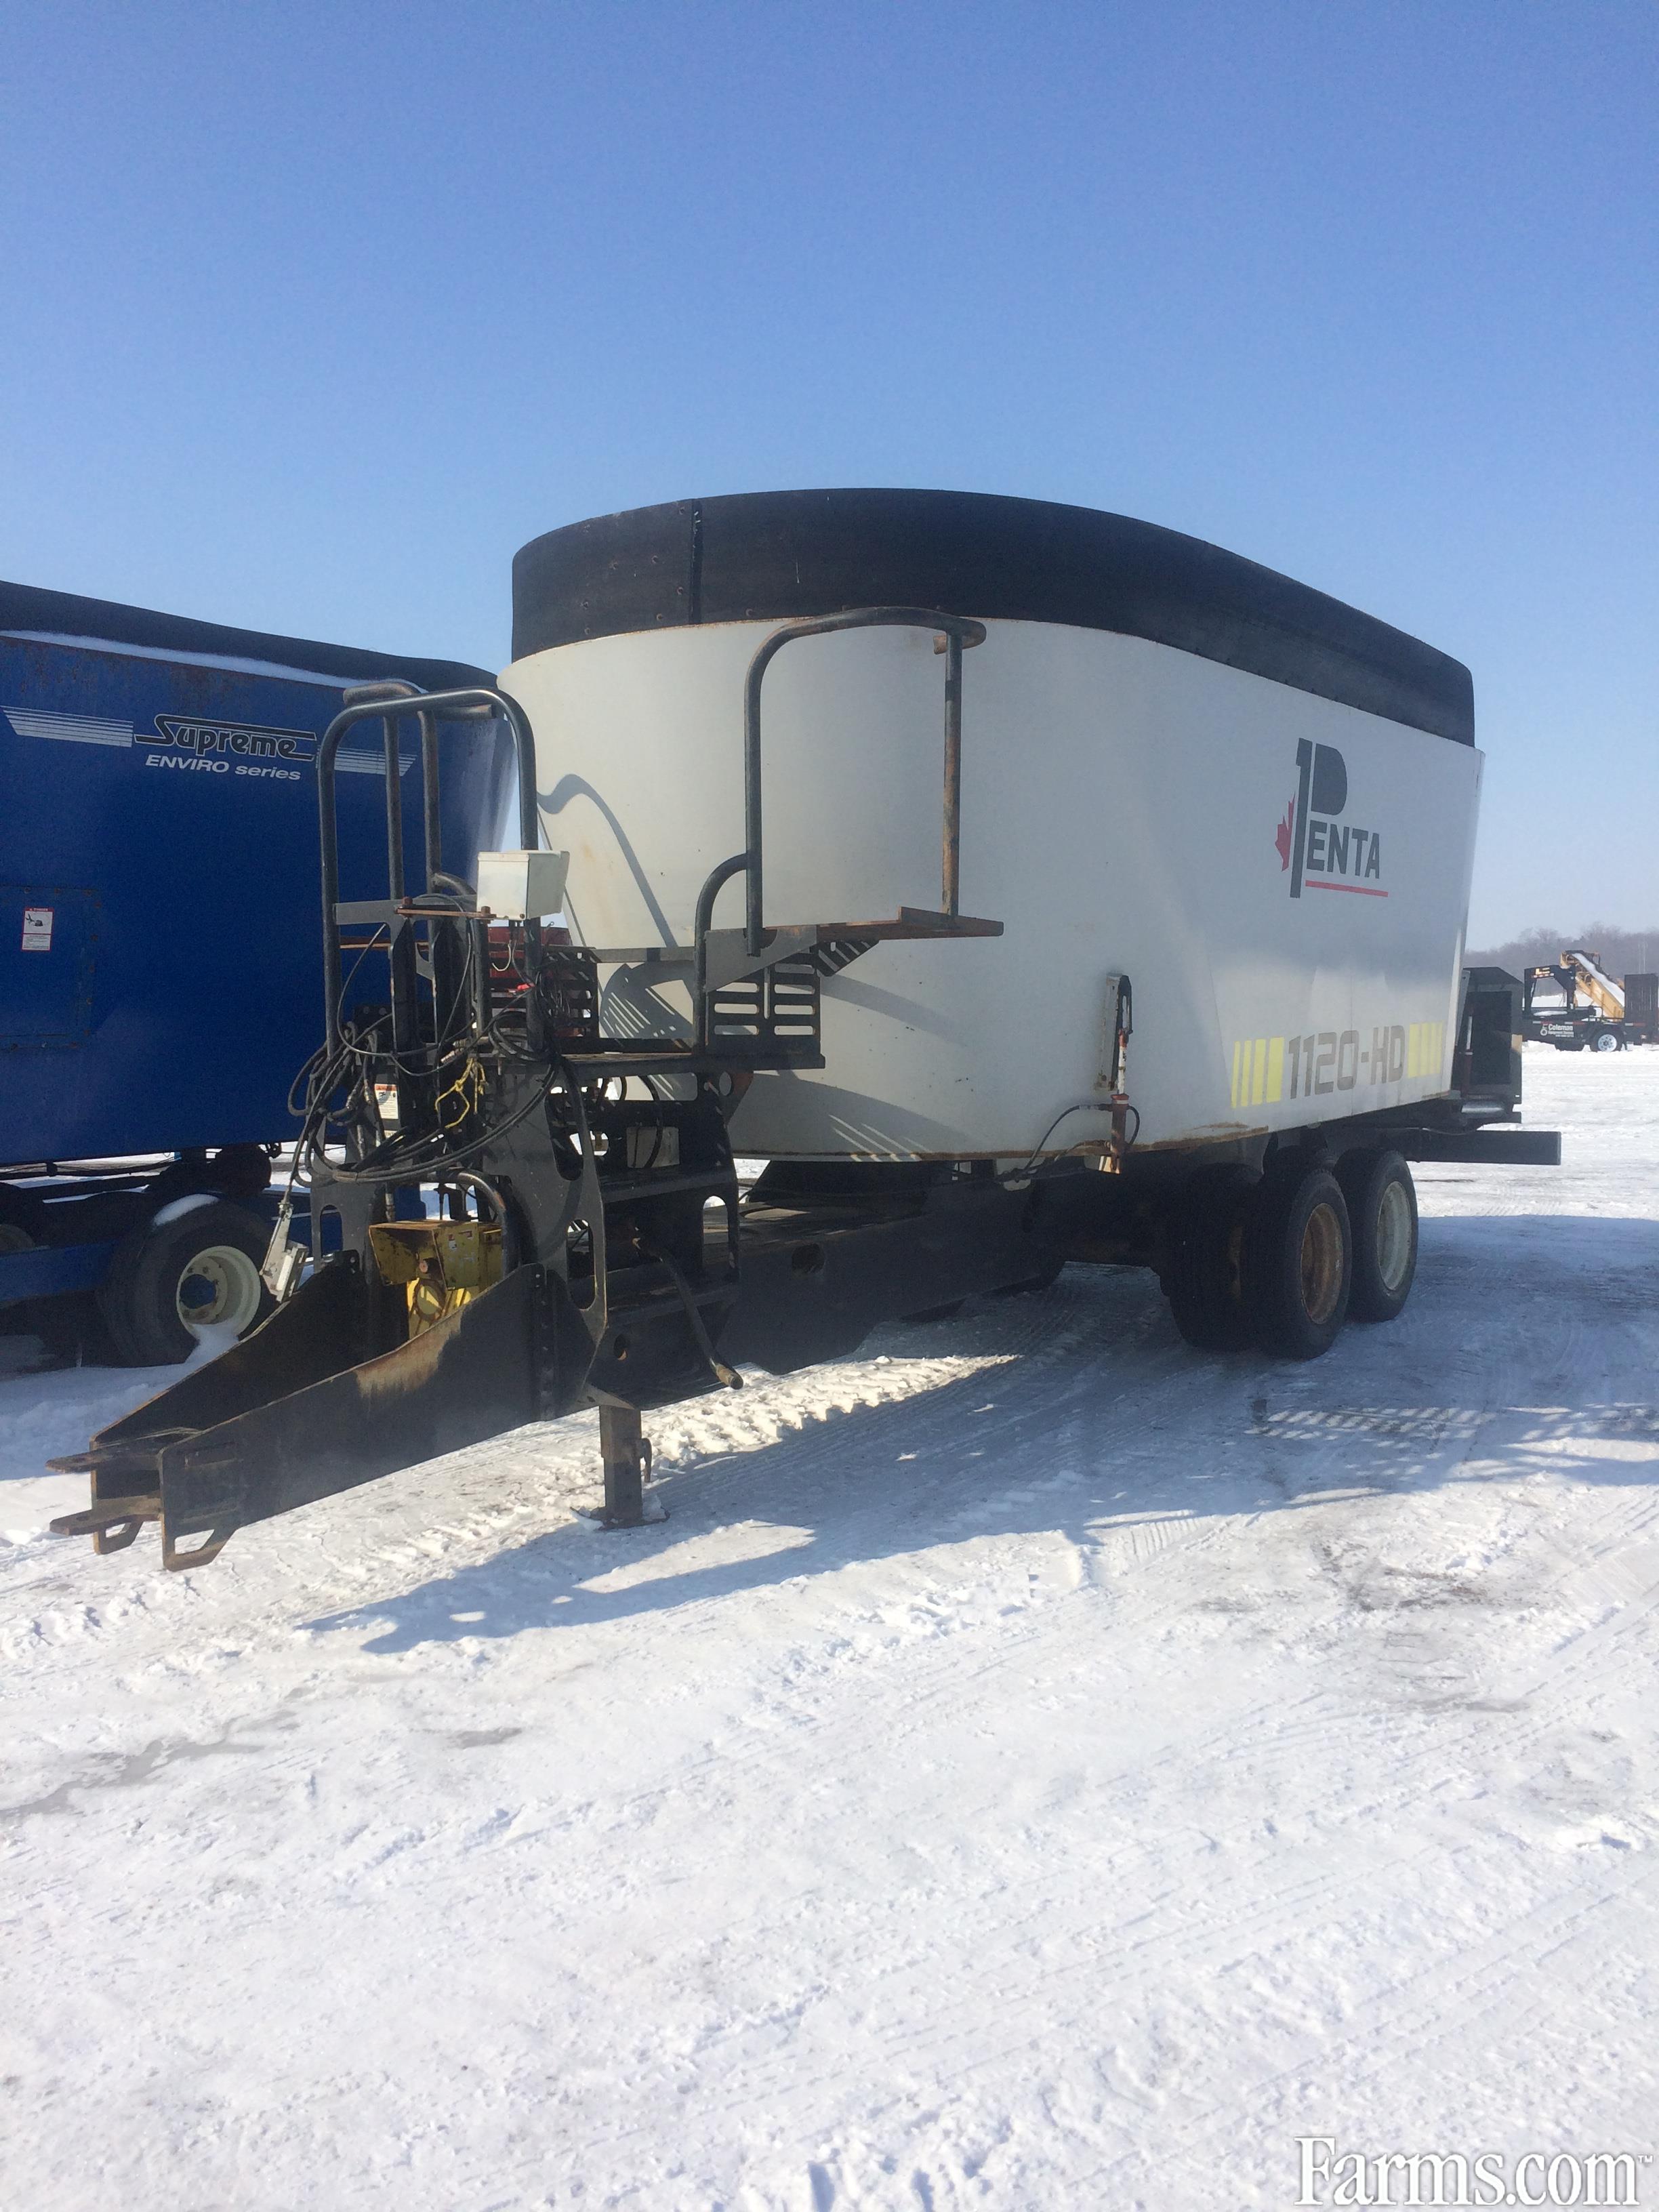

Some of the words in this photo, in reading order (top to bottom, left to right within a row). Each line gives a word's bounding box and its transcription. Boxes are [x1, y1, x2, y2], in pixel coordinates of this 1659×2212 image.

[134, 714, 316, 762] Supreme
[145, 754, 230, 773] ENVIRO
[234, 766, 302, 780] series
[1290, 737, 1380, 899] PENTA
[1288, 1025, 1406, 1099] 1120-HD
